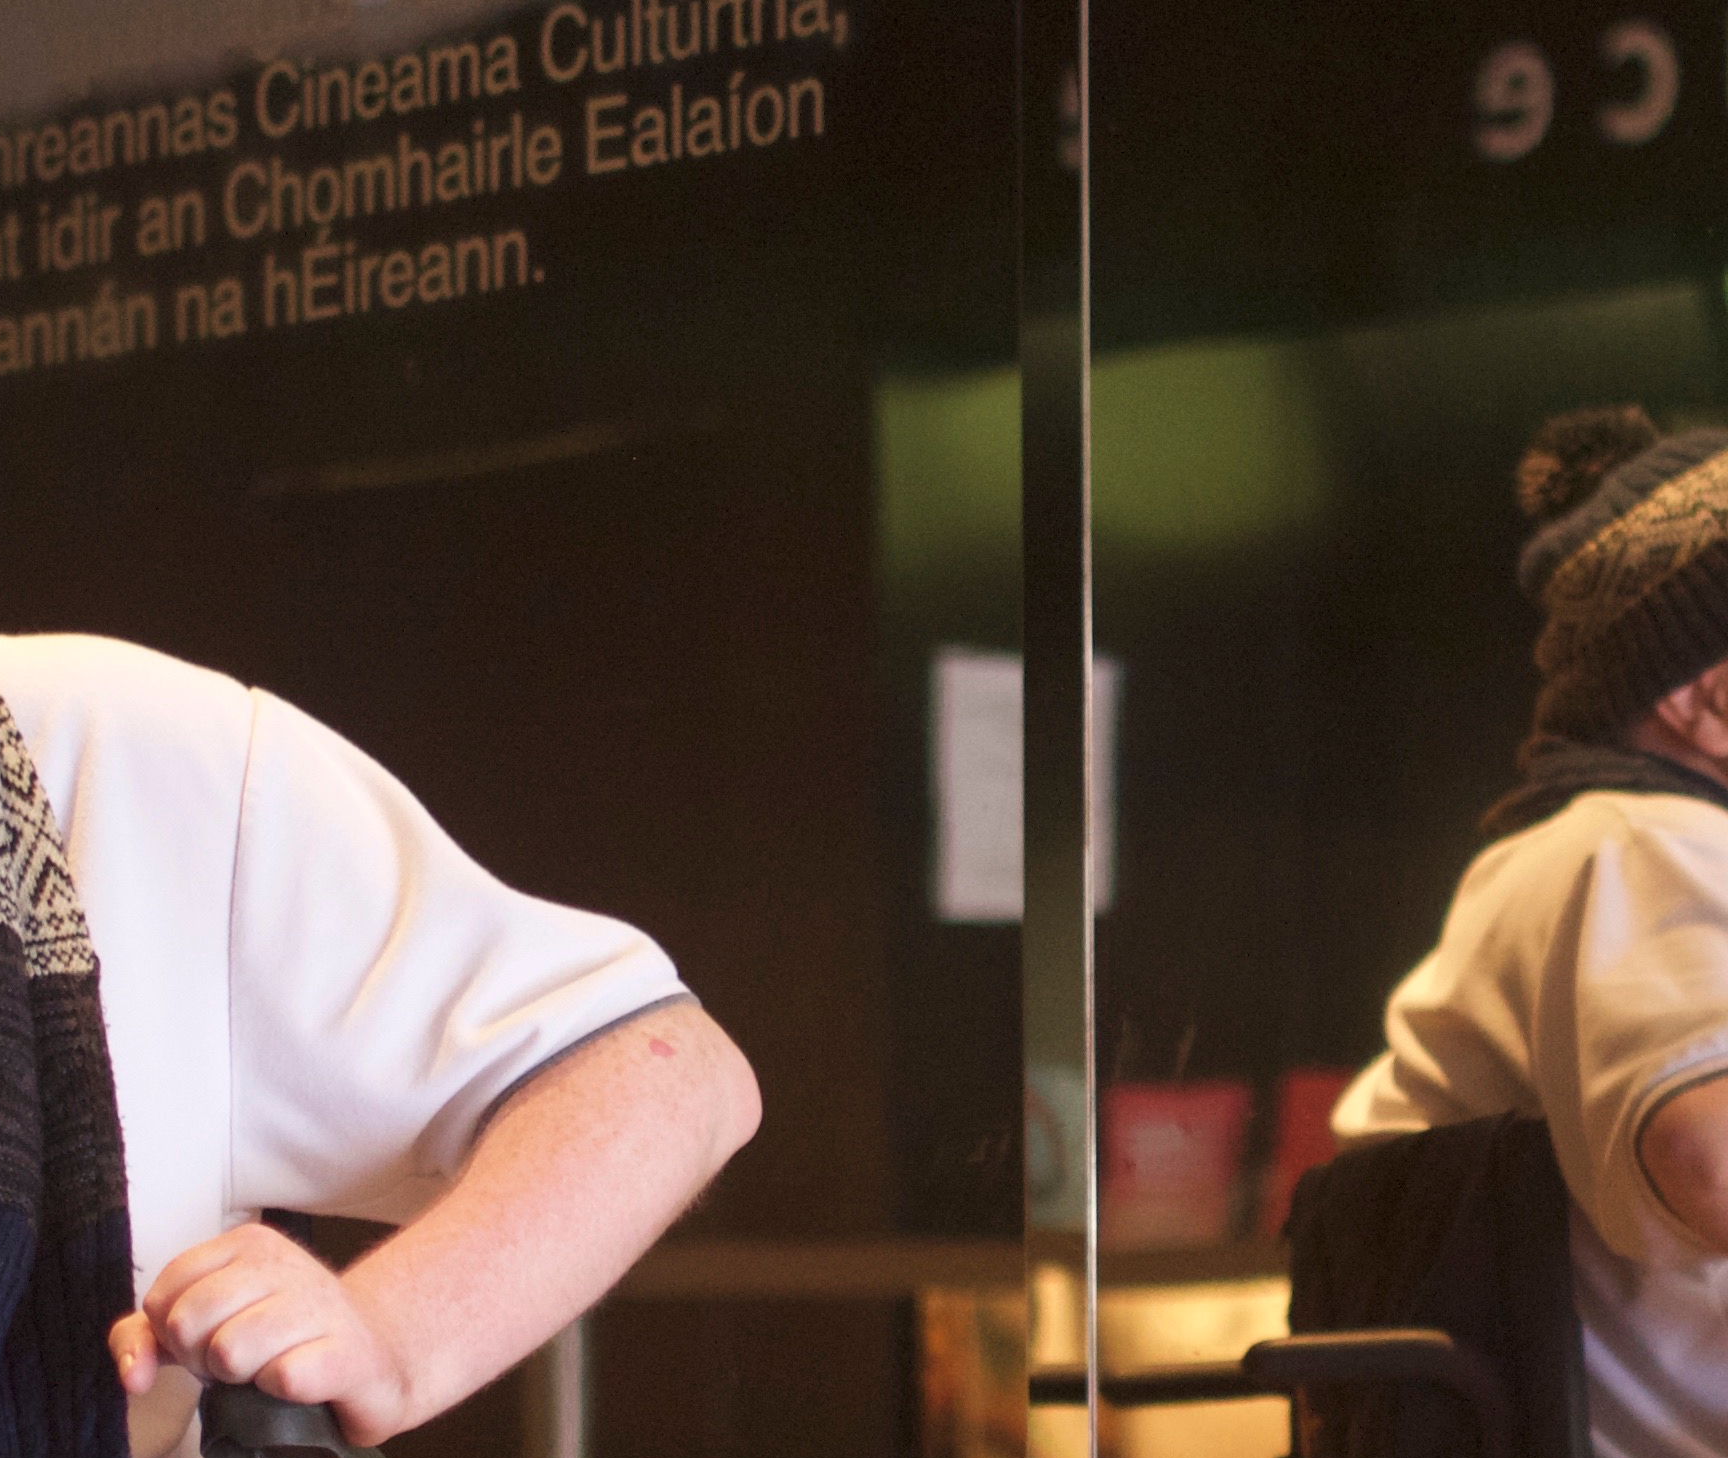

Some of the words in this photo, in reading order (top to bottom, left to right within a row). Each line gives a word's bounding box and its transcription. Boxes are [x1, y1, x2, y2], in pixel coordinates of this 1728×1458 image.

[255, 58, 519, 138] Cineama
[38, 192, 123, 273] idir
[136, 190, 207, 258] an
[225, 111, 564, 240] Chomhairle
[586, 70, 825, 174] Ealaíon
[175, 278, 246, 342] na
[264, 226, 546, 328] hÉireann.
